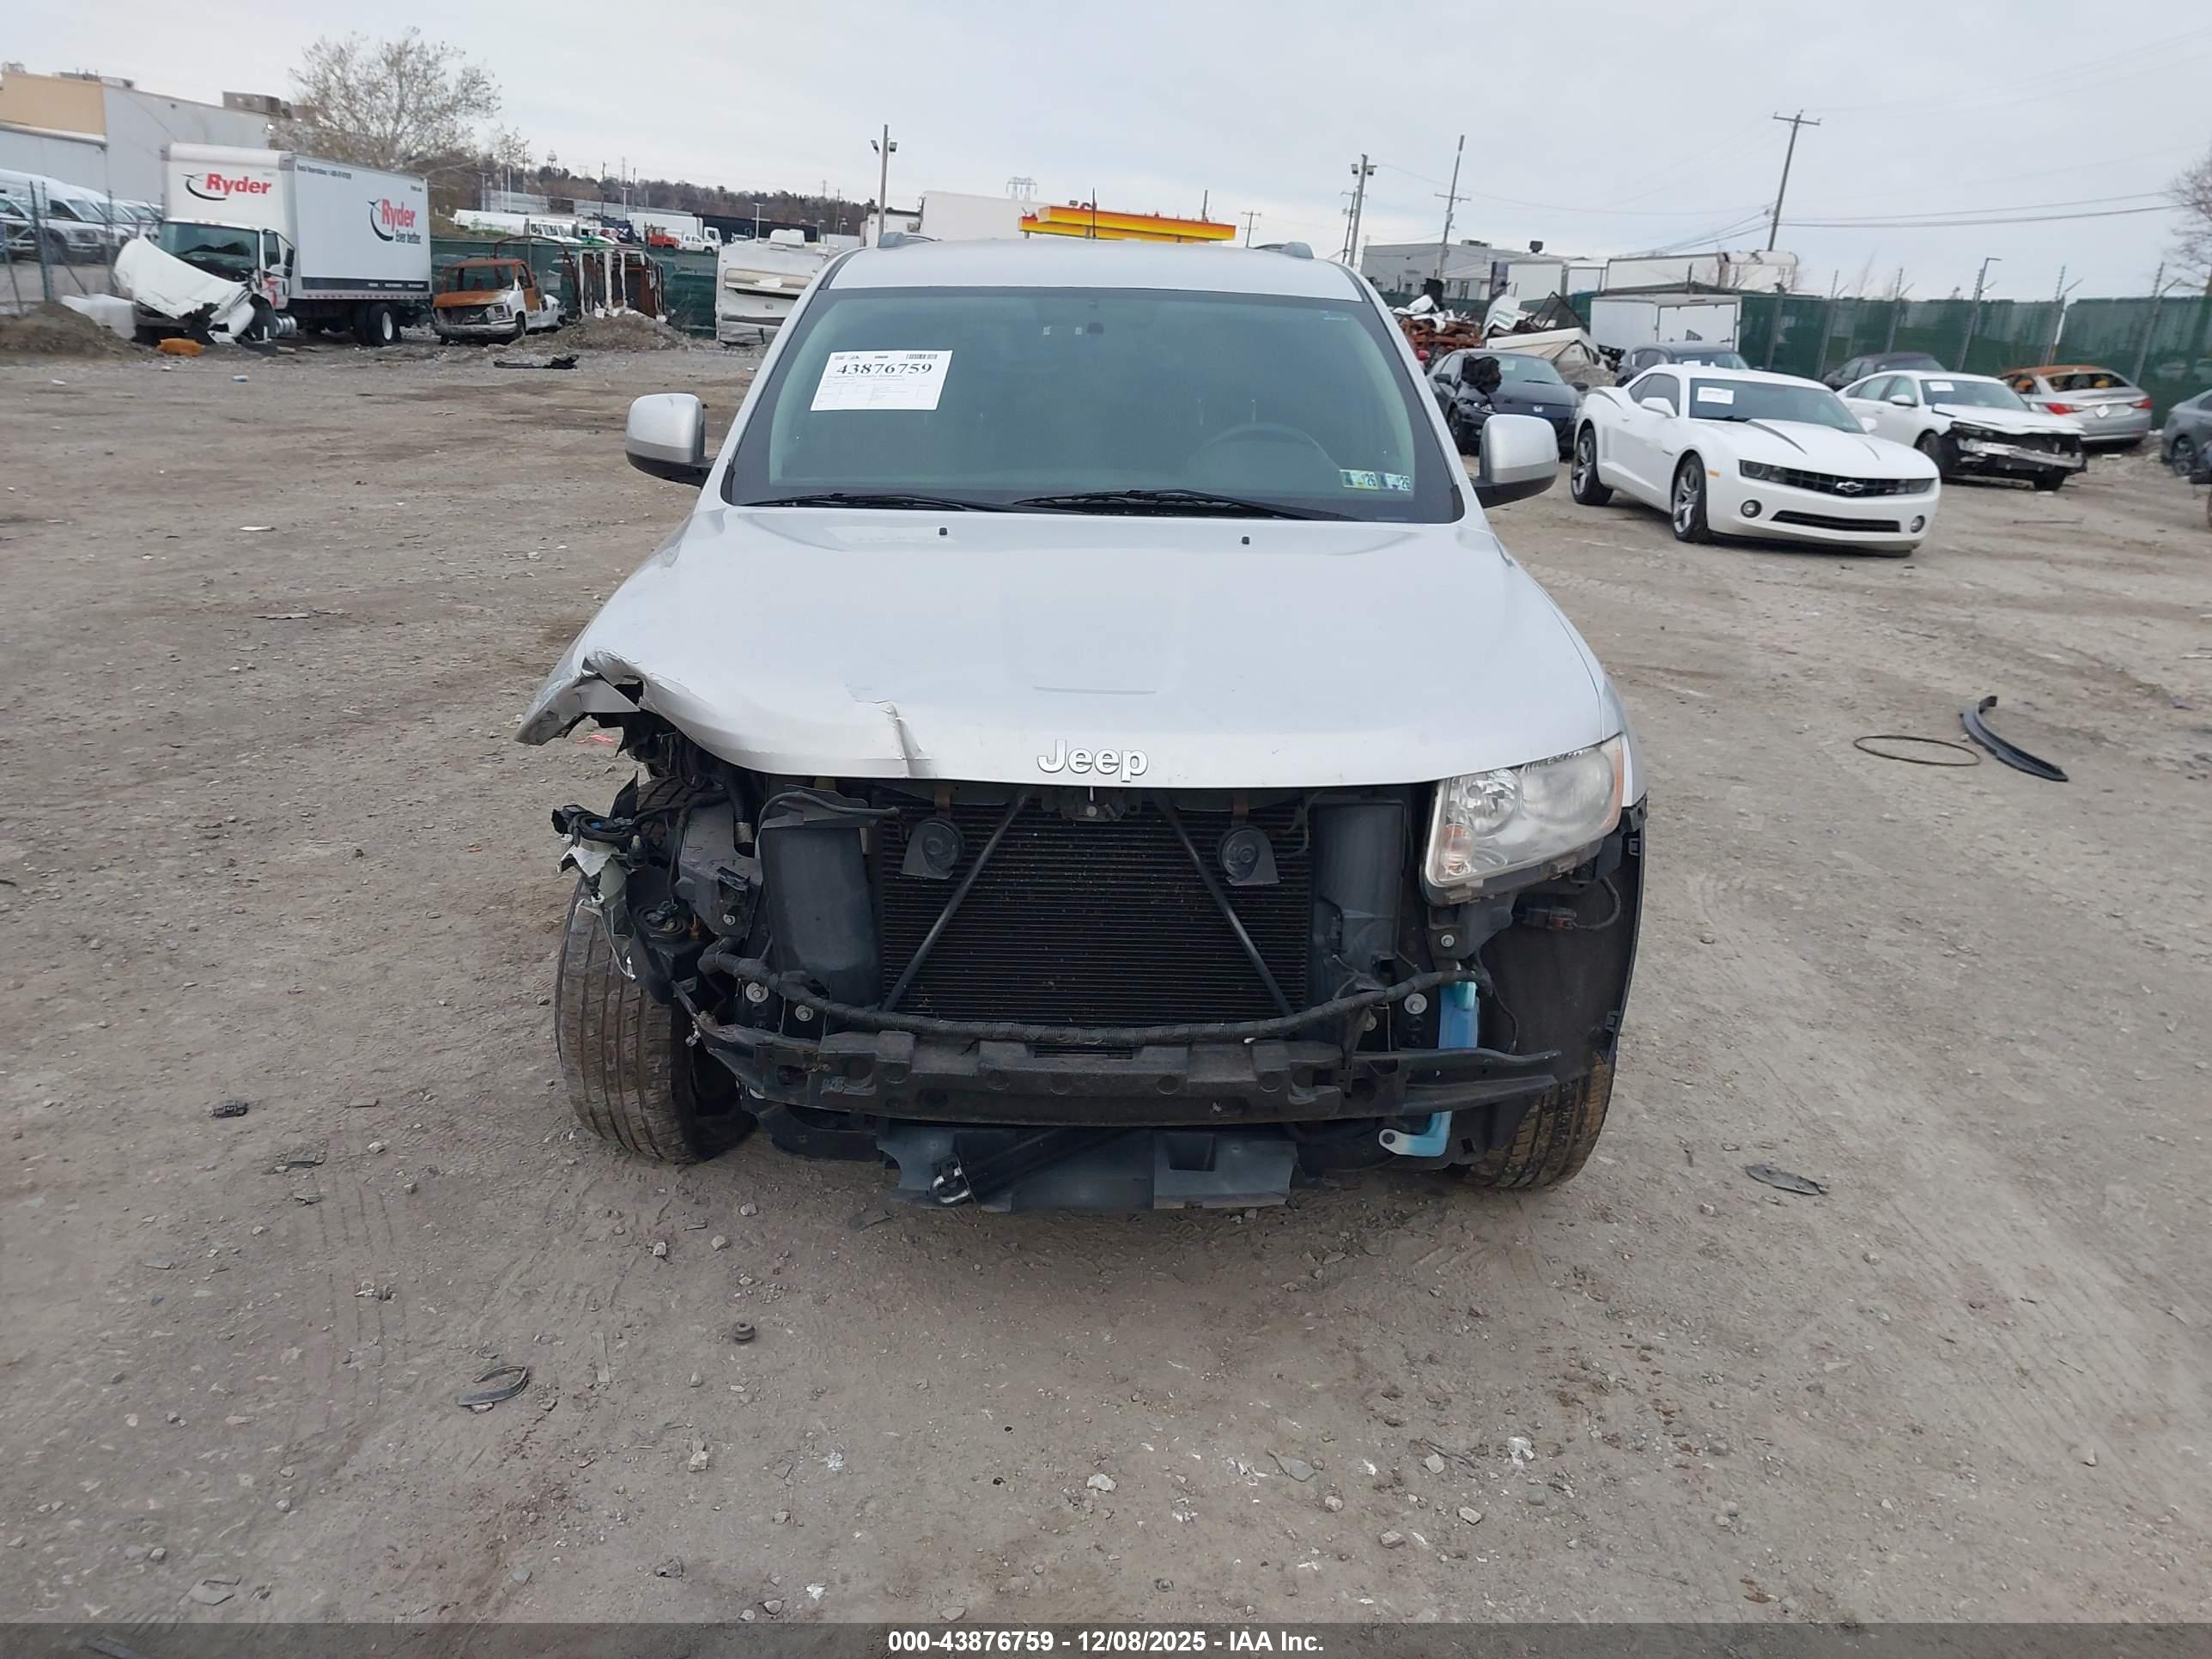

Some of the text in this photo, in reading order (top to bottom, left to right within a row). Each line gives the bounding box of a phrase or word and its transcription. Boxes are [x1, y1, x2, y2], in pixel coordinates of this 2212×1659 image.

[206, 173, 271, 196] Ryder
[381, 198, 416, 232] Ryder
[836, 363, 933, 374] 43876759
[1036, 738, 1149, 783] Jeep
